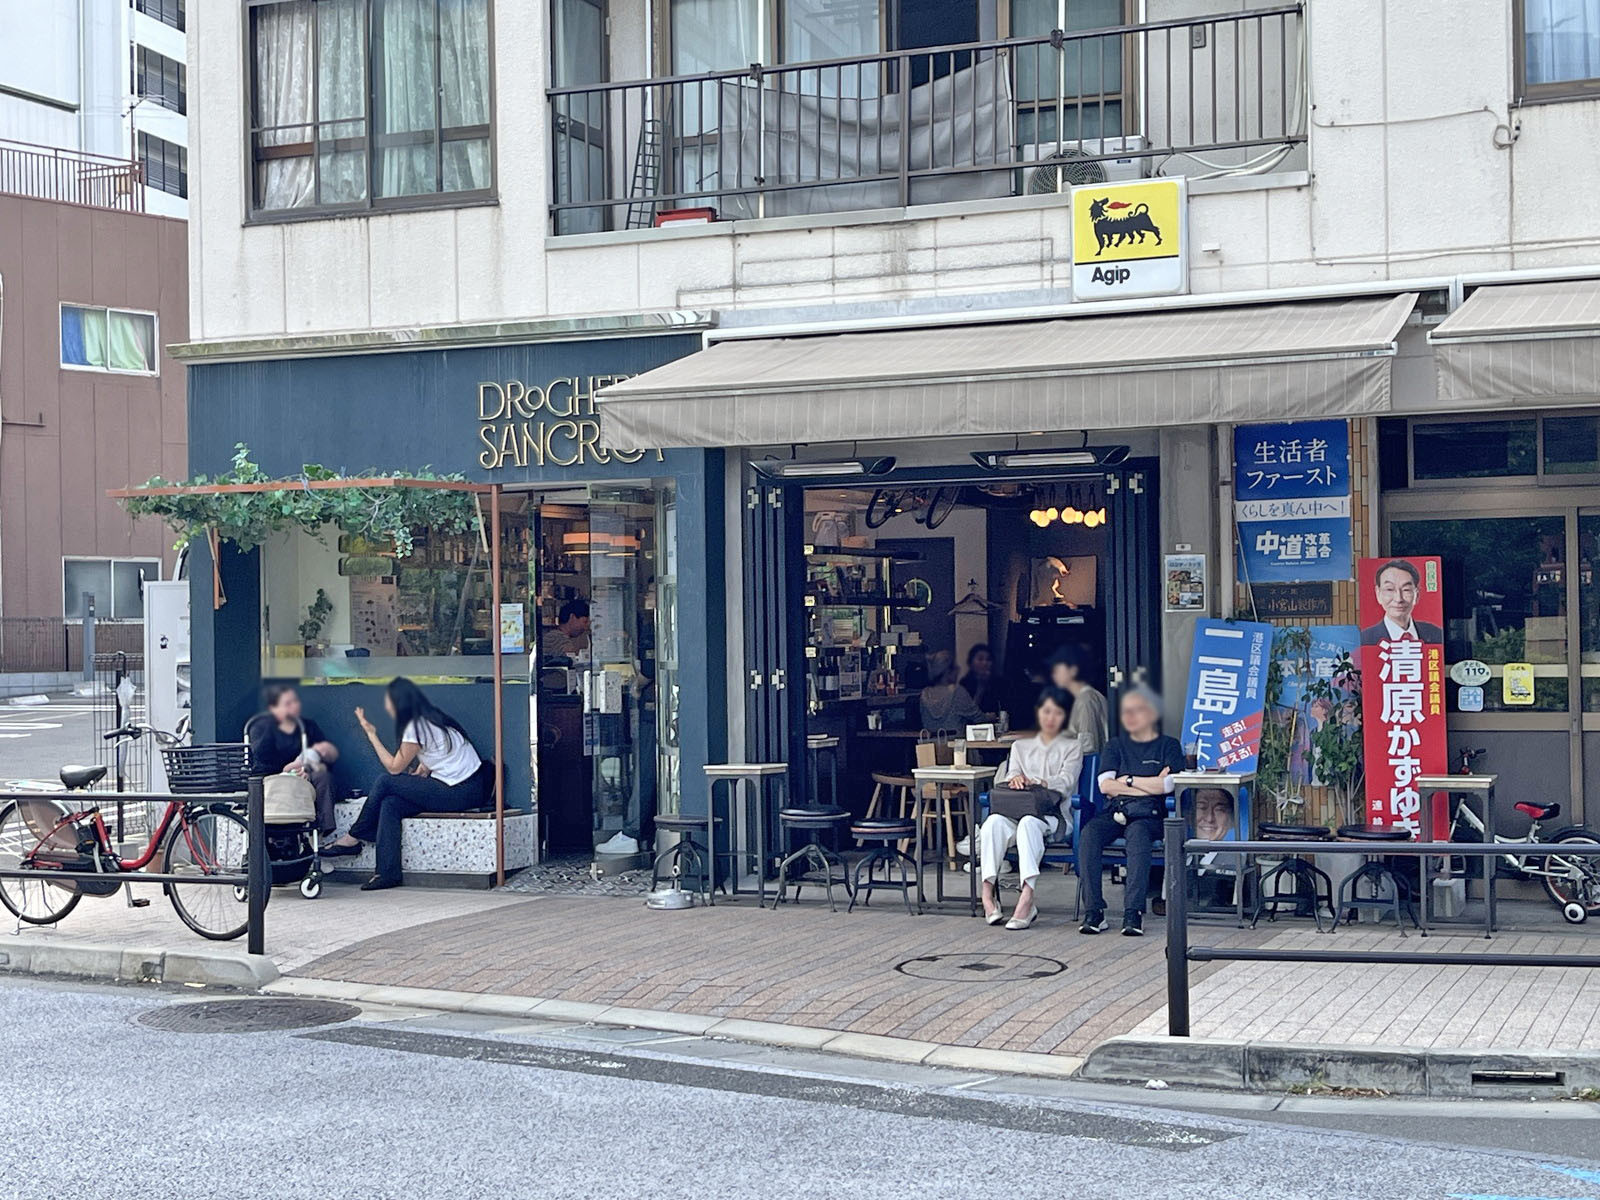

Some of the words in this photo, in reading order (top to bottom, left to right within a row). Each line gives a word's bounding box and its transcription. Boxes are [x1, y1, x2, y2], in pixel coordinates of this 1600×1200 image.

[1091, 265, 1131, 286] Agip
[1254, 438, 1329, 464] 生活者
[1246, 465, 1337, 489] ファースト
[1255, 530, 1303, 560] 中道
